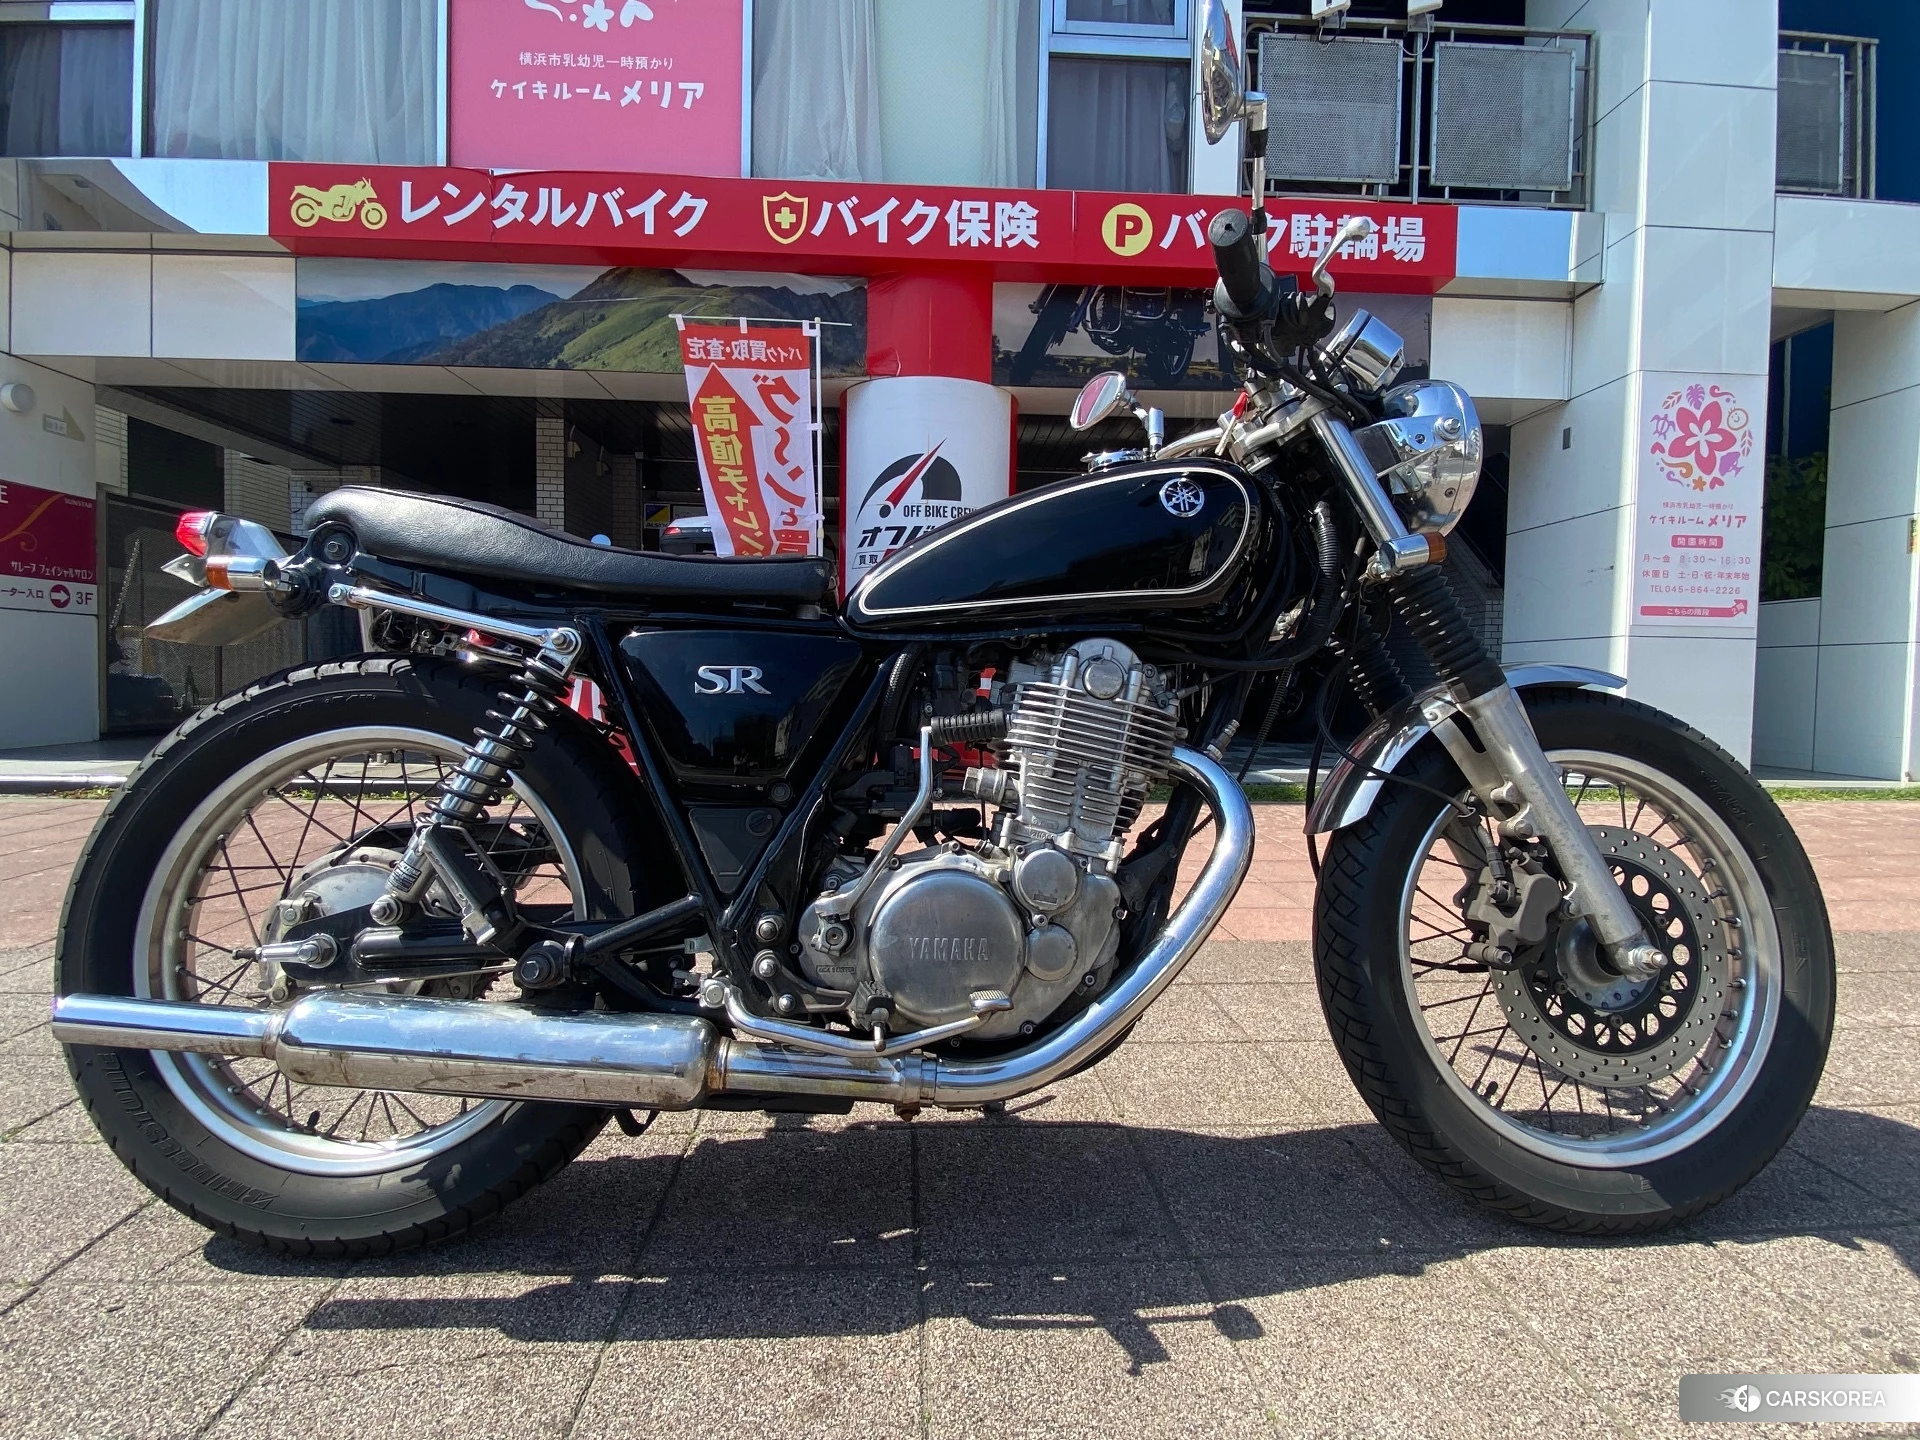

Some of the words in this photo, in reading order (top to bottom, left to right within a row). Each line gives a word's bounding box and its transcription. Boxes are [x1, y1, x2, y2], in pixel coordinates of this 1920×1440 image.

[518, 51, 674, 71] 横浜市乳幼児一時預かり
[401, 179, 709, 238] レンタルバイク
[810, 195, 1040, 249] バイク保険
[1159, 208, 1426, 263] バク駐輪場
[903, 504, 922, 518] OFF
[924, 505, 949, 519] BIKE
[858, 554, 878, 566] 買取
[76, 591, 94, 606] 3F
[694, 665, 772, 695] SR
[908, 937, 990, 962] YAMAHA
